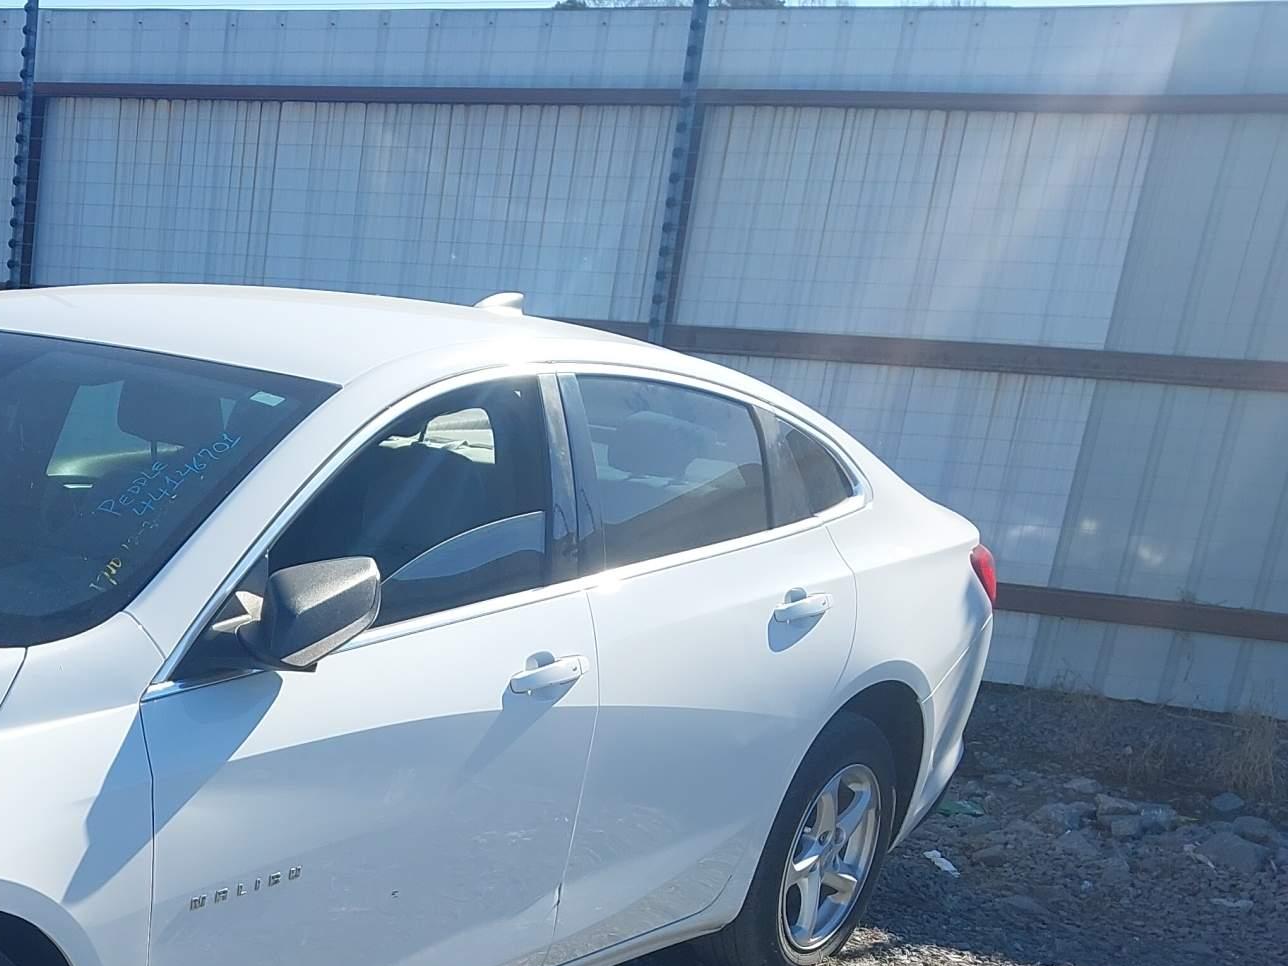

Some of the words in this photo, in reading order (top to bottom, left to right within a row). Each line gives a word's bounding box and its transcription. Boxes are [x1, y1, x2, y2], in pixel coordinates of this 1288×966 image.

[97, 460, 169, 516] PEDDLE
[132, 432, 241, 516] 44146701
[190, 864, 303, 912] MALIBU
